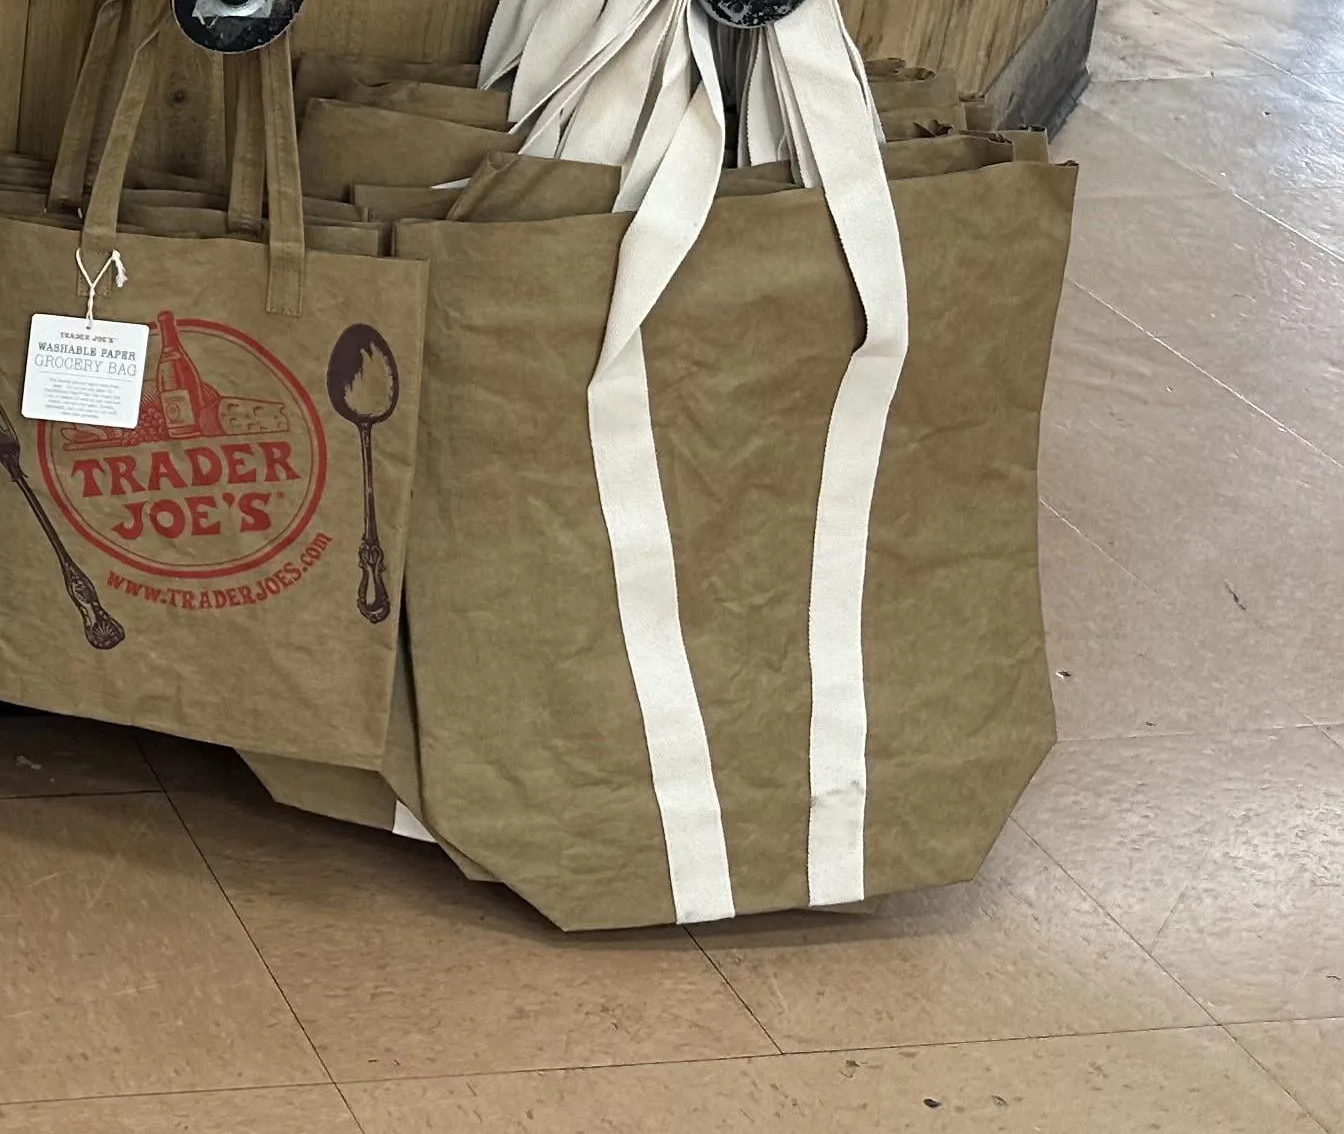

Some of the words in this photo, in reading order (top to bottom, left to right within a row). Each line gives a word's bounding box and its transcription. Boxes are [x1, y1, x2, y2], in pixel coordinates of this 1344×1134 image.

[59, 331, 89, 341] TRADER
[38, 341, 97, 357] WASHABLE
[101, 348, 136, 361] PAPER
[34, 353, 103, 373] GROCERY
[108, 361, 137, 378] BAG
[71, 440, 300, 498] TRADER
[112, 491, 275, 540] JOE'S
